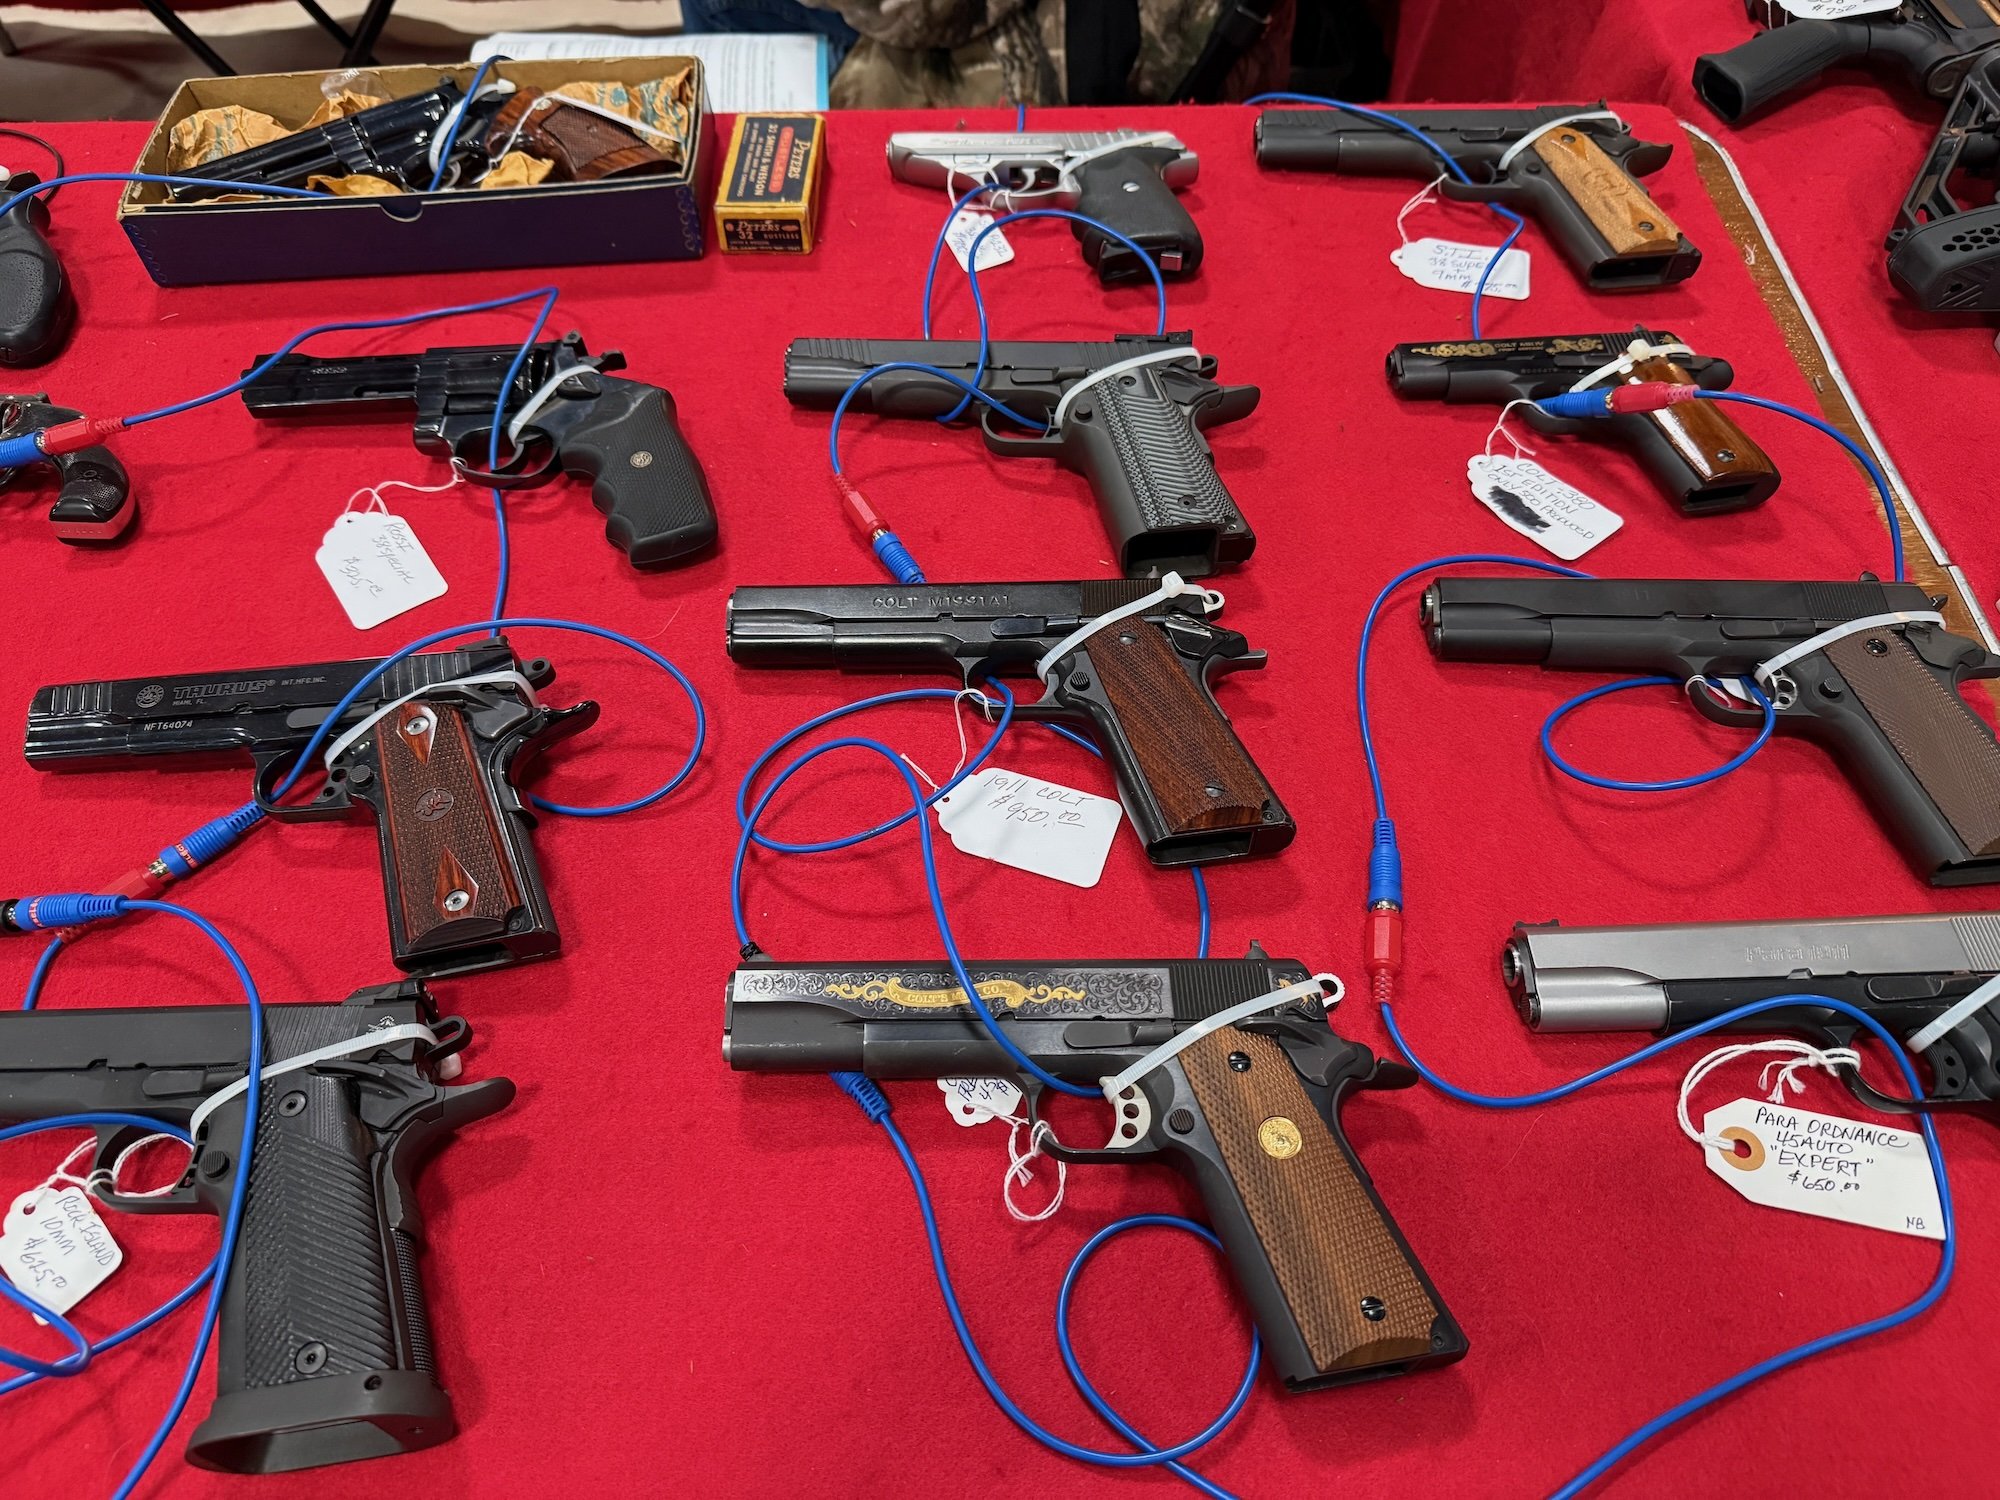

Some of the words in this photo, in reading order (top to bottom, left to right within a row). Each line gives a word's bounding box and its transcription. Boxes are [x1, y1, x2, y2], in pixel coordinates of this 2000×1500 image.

[762, 134, 776, 157] SMITH
[788, 138, 811, 180] PETERS
[754, 165, 770, 196] WESSON
[736, 221, 780, 232] PETERS
[738, 231, 754, 240] 32
[1487, 473, 1522, 491] ONLY
[1516, 462, 1562, 486] COLT
[1493, 465, 1523, 479] 1ST
[1521, 479, 1579, 515] EDITION
[384, 522, 415, 553] ROSSI
[872, 597, 919, 609] COLT
[928, 595, 1009, 608] M1991A1
[143, 720, 194, 732] NFT64074
[983, 774, 1029, 793] 1911
[1036, 787, 1095, 807] COLT
[907, 993, 949, 1004] COLT'S
[1755, 1106, 1799, 1130] PARA
[55, 1195, 87, 1229] ROCK
[79, 1221, 116, 1266] ISLAND
[1906, 1216, 1926, 1230] NB
